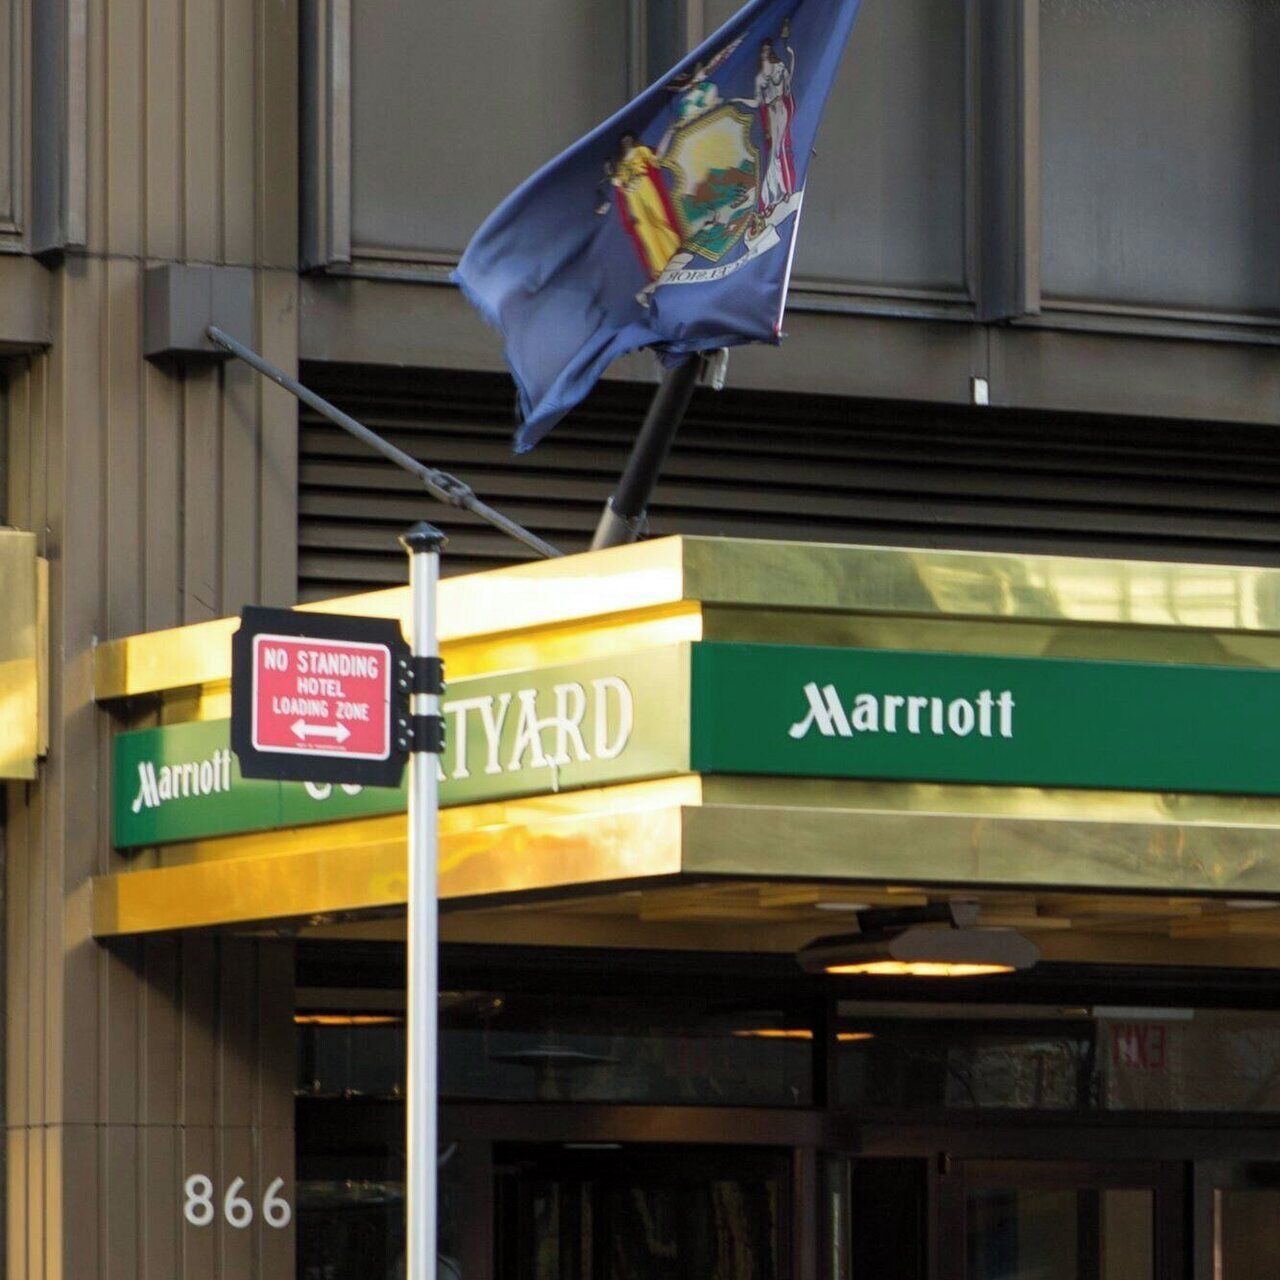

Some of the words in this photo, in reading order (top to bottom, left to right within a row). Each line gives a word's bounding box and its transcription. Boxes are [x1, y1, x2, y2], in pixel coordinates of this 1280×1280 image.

[264, 648, 288, 672] NO
[297, 650, 378, 679] STANDING
[272, 697, 329, 718] LOADING
[336, 701, 370, 721] ZONE
[297, 677, 346, 698] HOTEL
[788, 681, 1016, 739] Marriott
[131, 748, 231, 814] Marriott
[183, 1174, 292, 1229] 866
